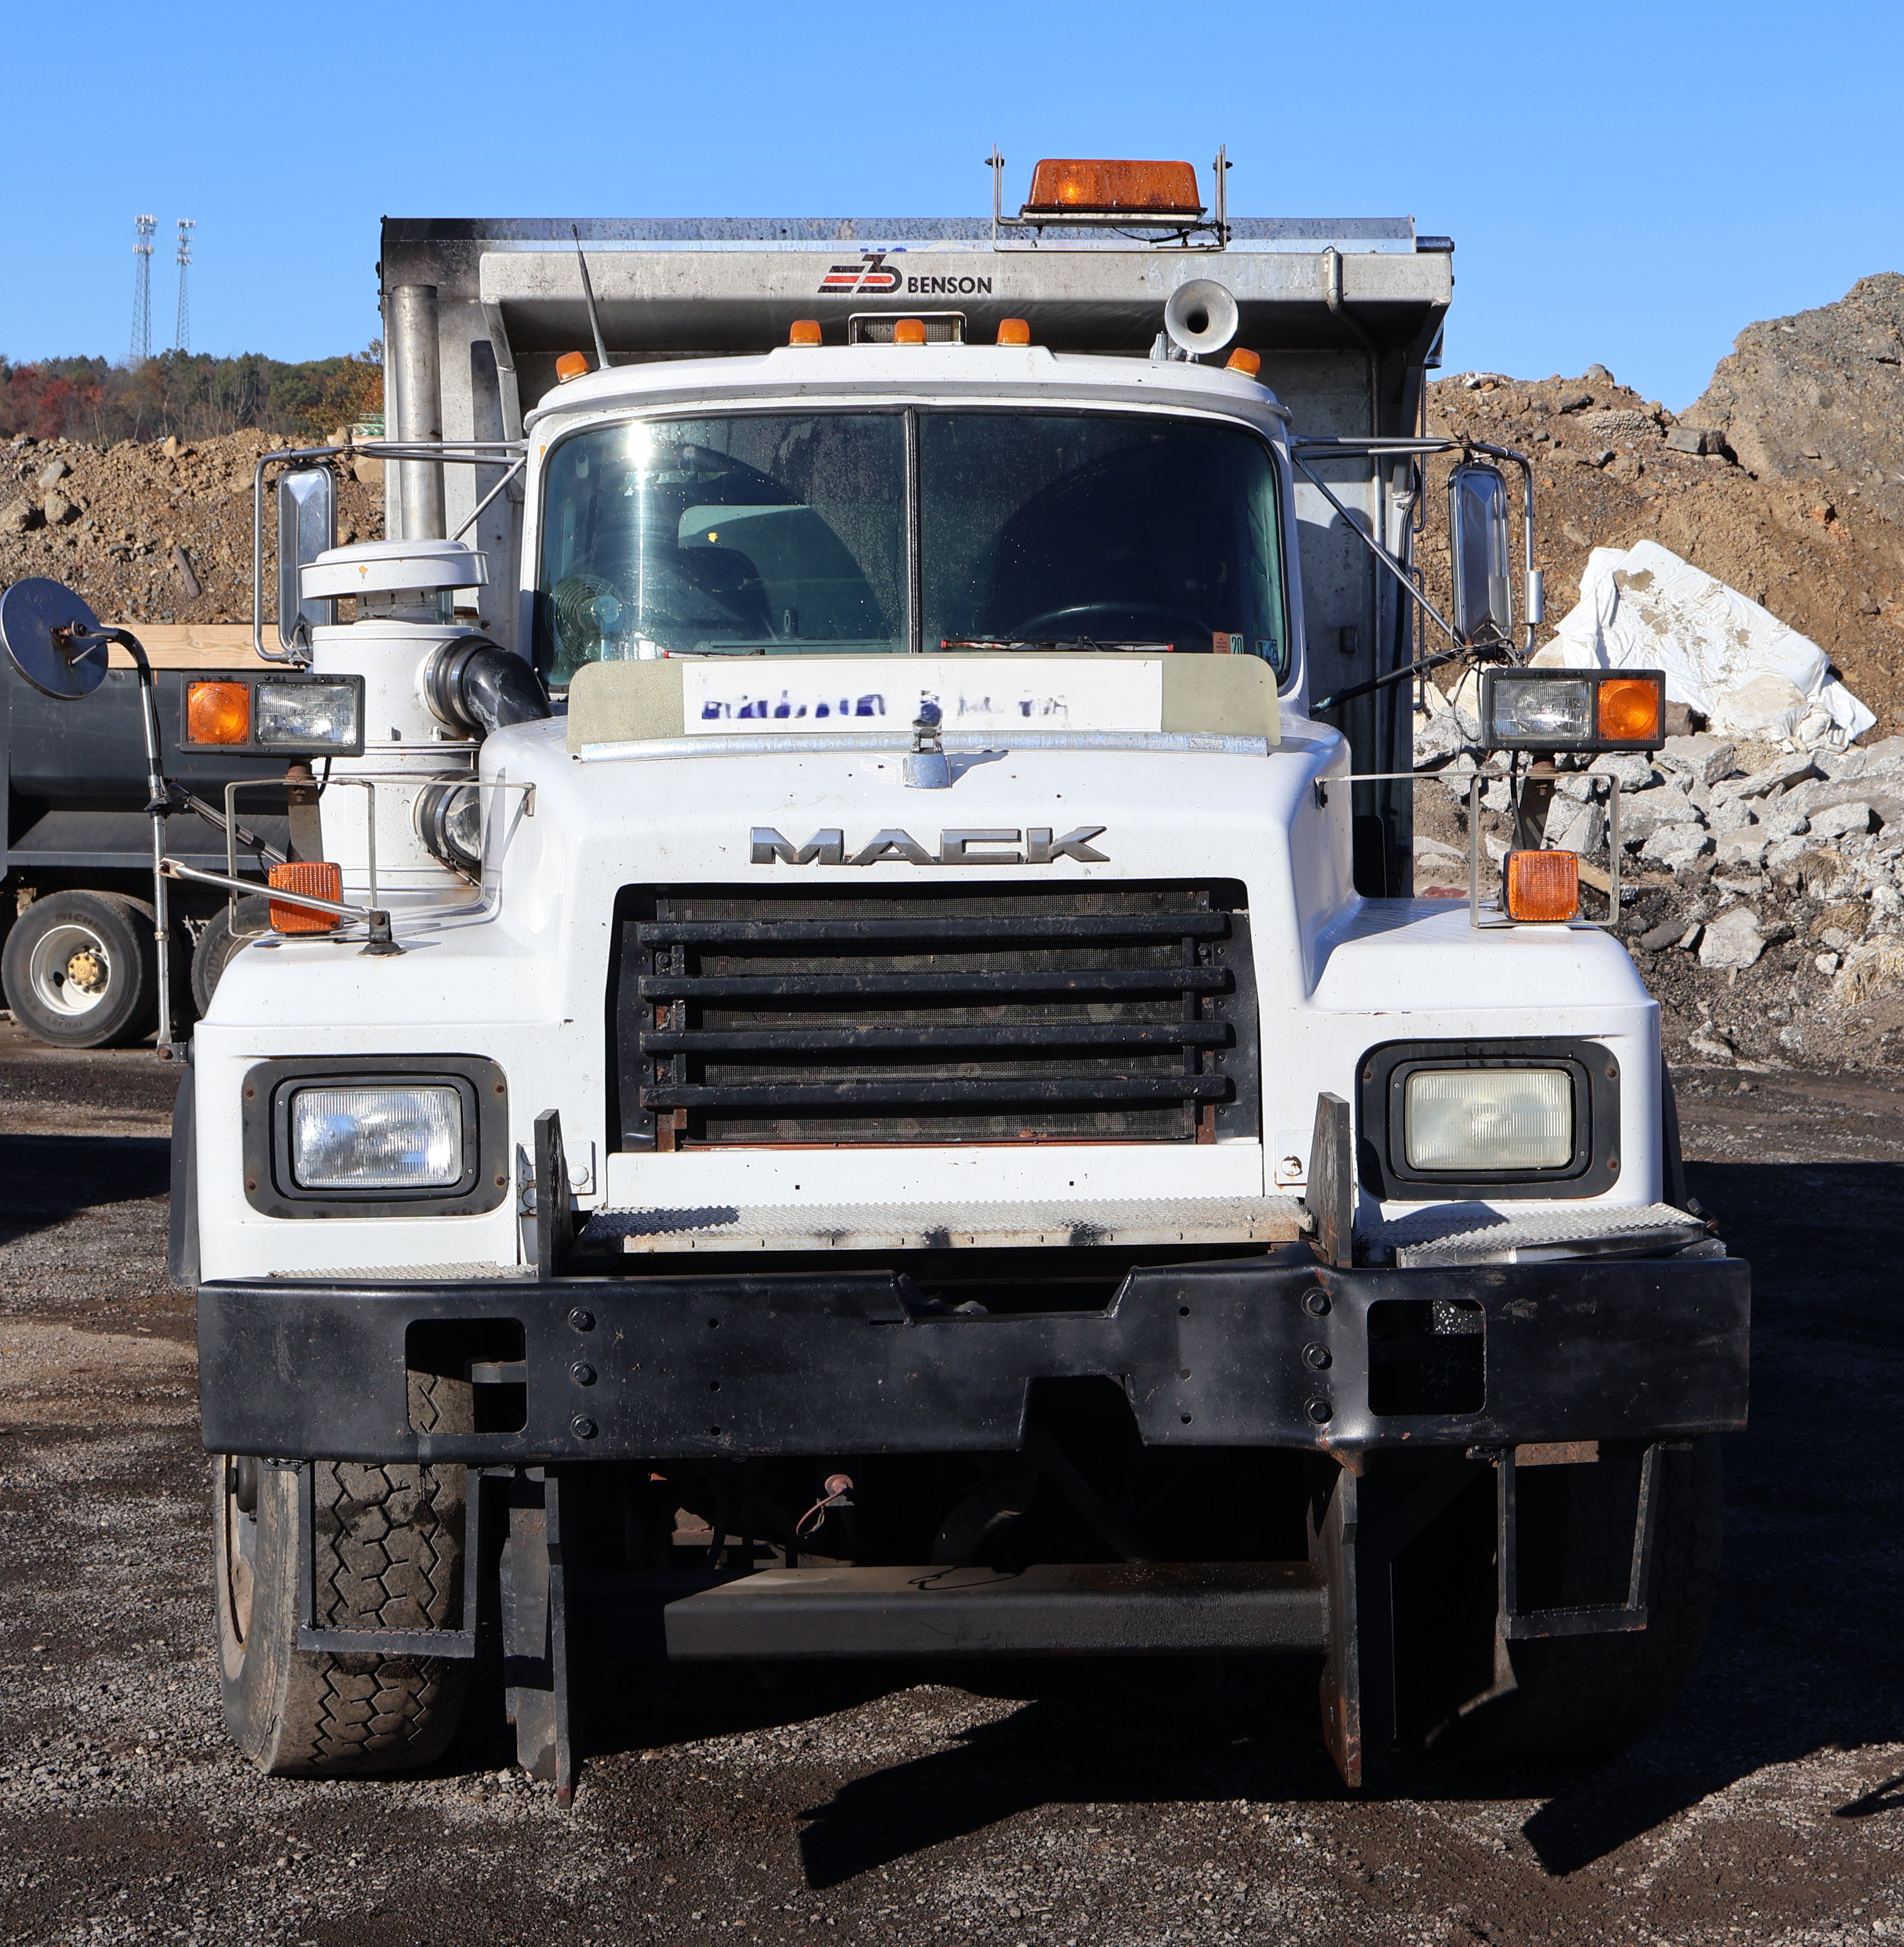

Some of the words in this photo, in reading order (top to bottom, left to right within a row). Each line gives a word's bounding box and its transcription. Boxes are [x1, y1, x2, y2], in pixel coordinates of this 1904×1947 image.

[908, 276, 992, 294] BENSON
[750, 826, 1110, 865] MACK
[55, 911, 117, 953] MICHELIN
